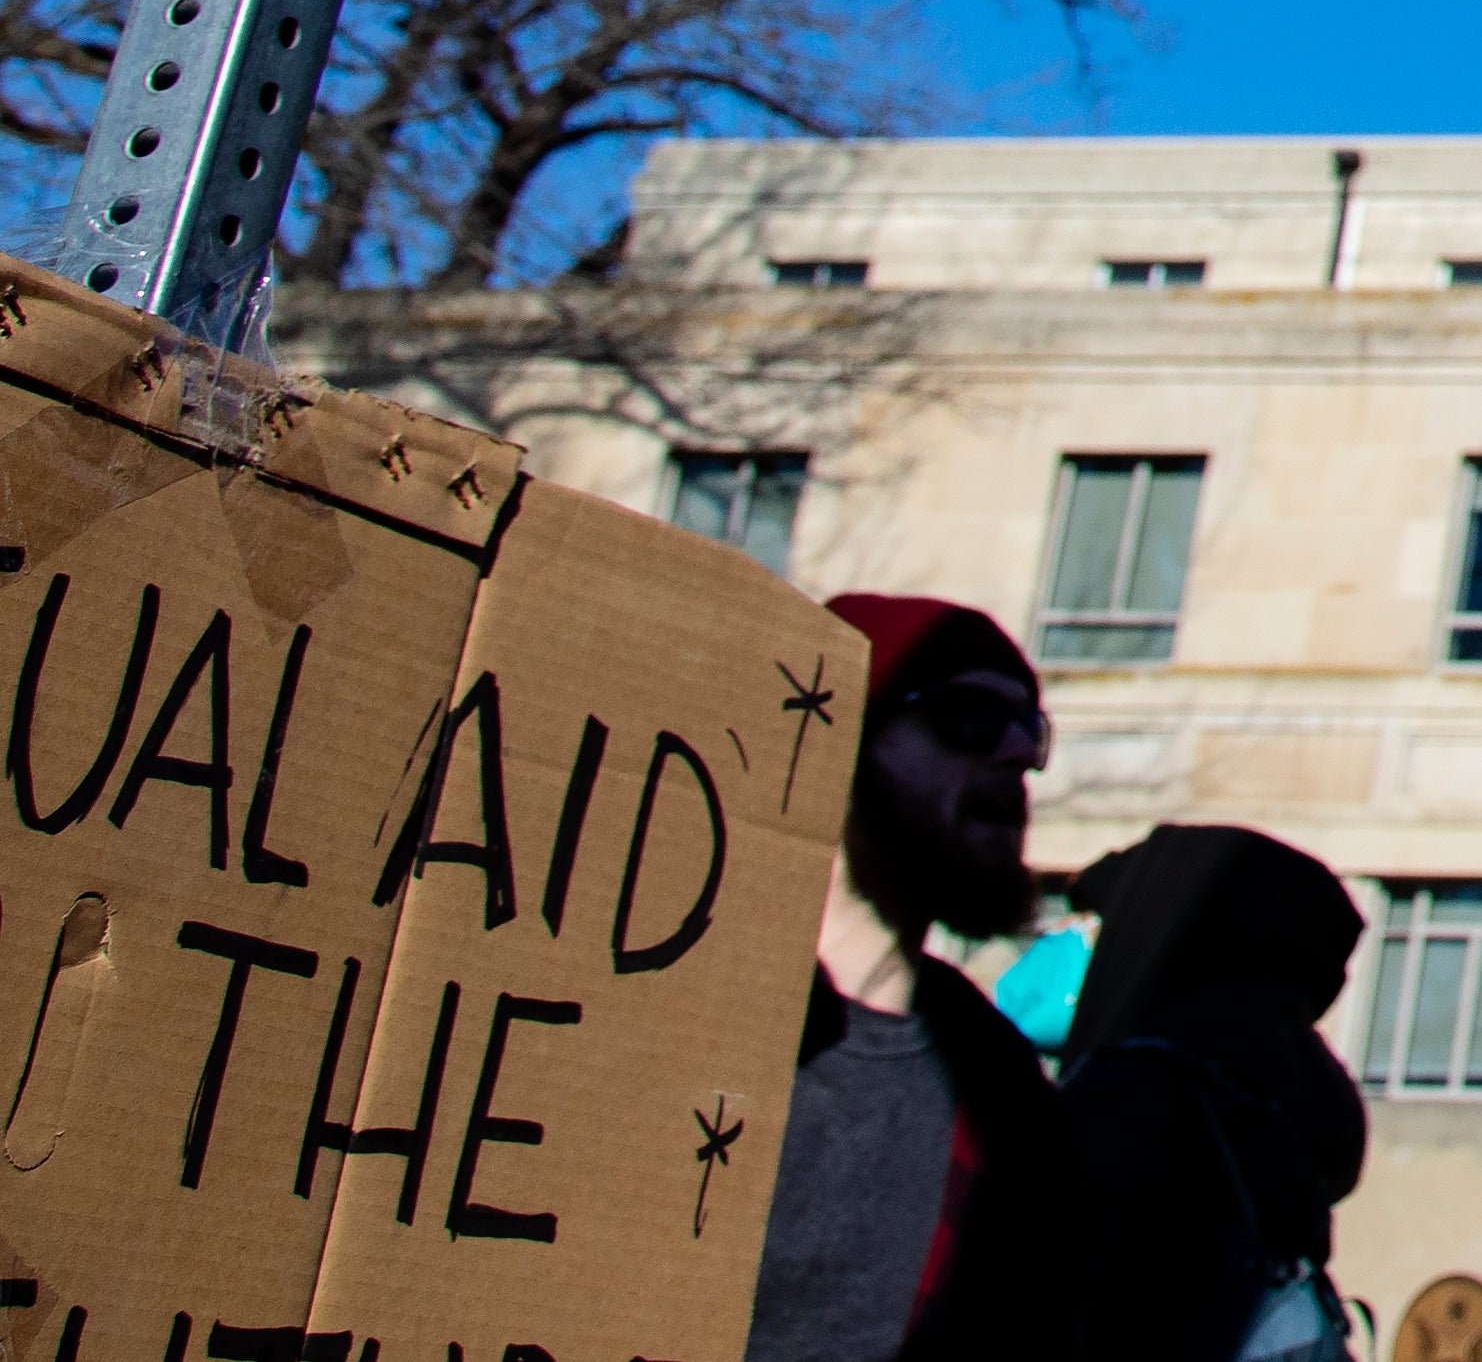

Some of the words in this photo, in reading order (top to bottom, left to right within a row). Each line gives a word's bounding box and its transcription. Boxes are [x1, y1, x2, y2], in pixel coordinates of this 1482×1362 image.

[0, 546, 312, 887] UAL
[372, 671, 728, 974] AID
[177, 921, 582, 1243] THE
